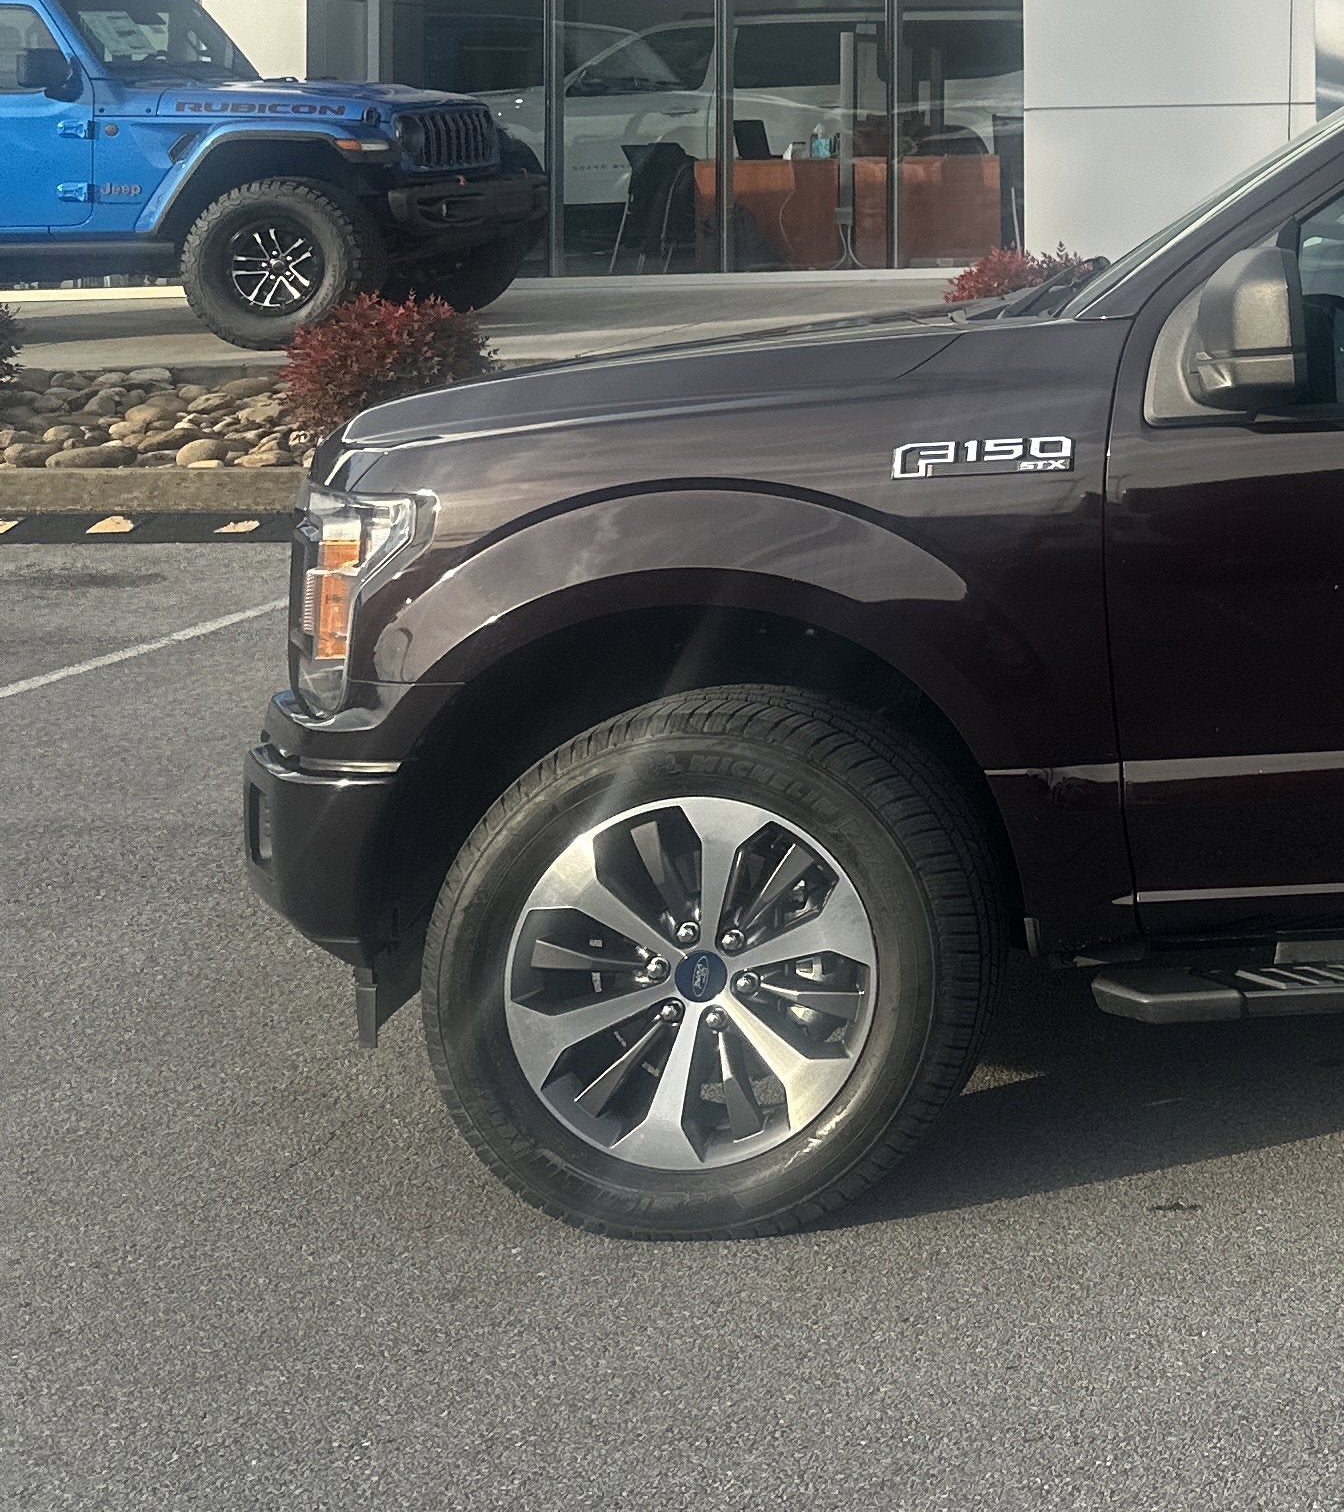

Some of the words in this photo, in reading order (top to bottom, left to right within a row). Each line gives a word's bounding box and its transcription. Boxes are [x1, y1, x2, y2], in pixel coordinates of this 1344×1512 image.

[174, 101, 347, 117] RUBICON
[1016, 458, 1071, 472] STX
[687, 753, 841, 816] MICHELIN
